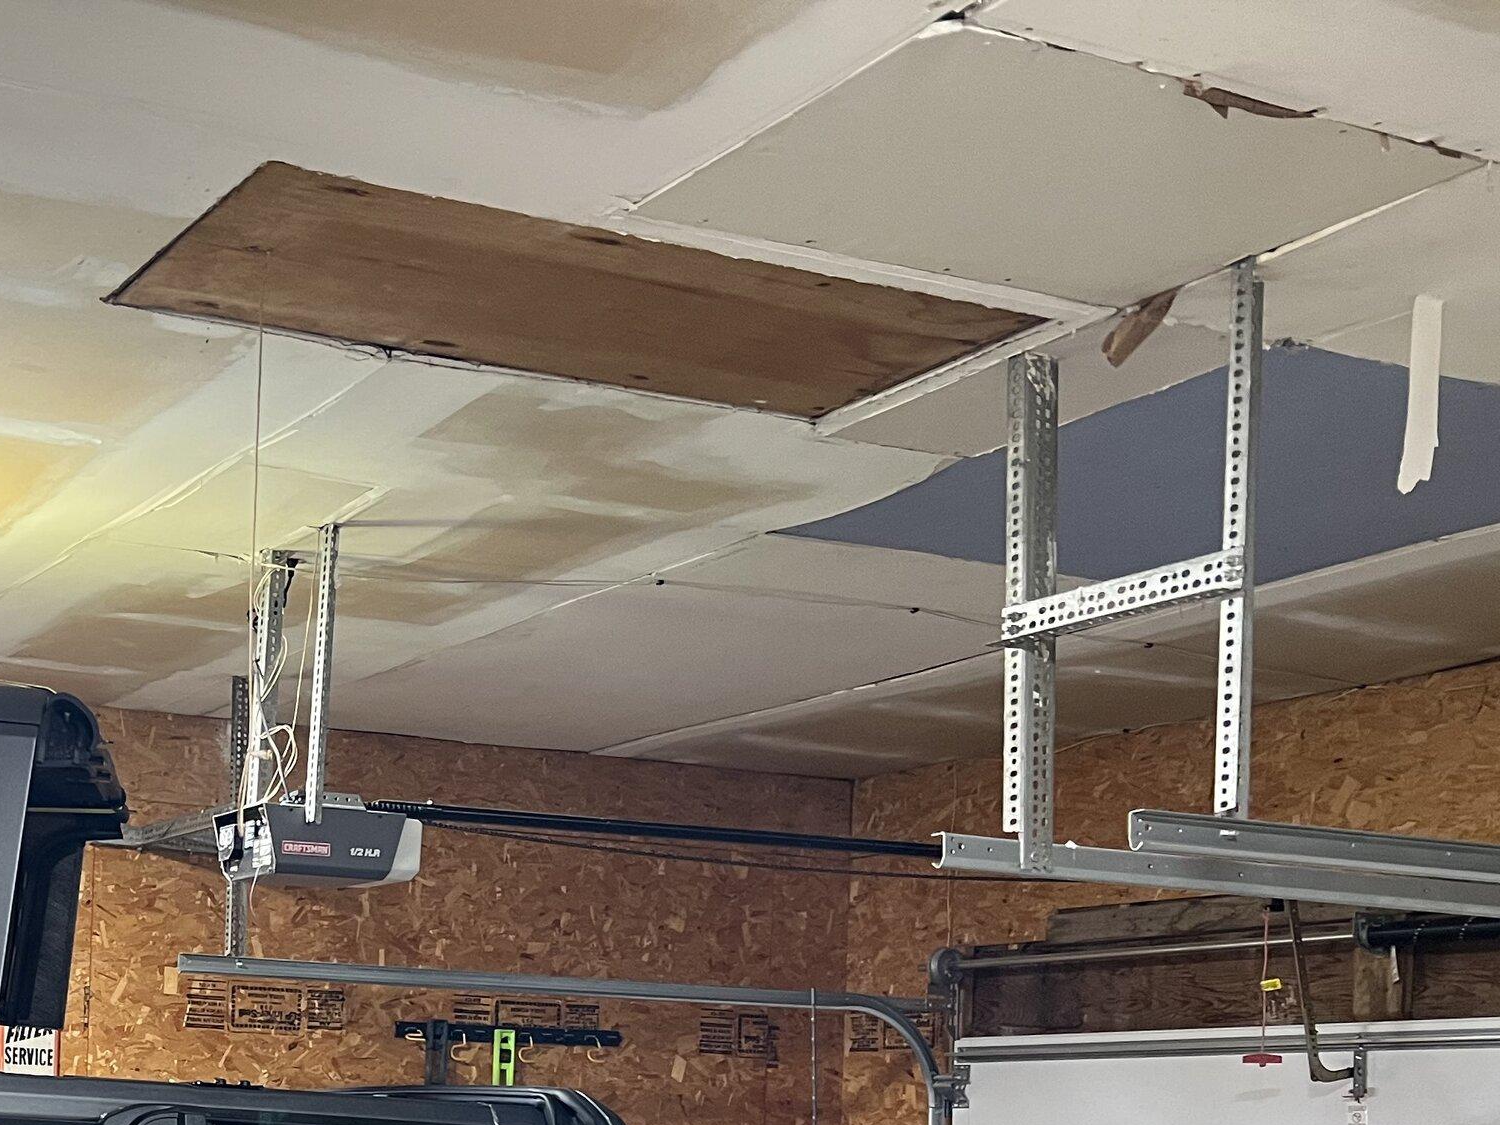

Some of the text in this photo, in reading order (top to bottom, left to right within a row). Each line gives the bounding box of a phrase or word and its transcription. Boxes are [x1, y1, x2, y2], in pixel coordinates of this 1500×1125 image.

[283, 843, 329, 855] CRAFTSMAN
[350, 847, 365, 857] 1/2
[4, 1046, 53, 1066] SERVICE
